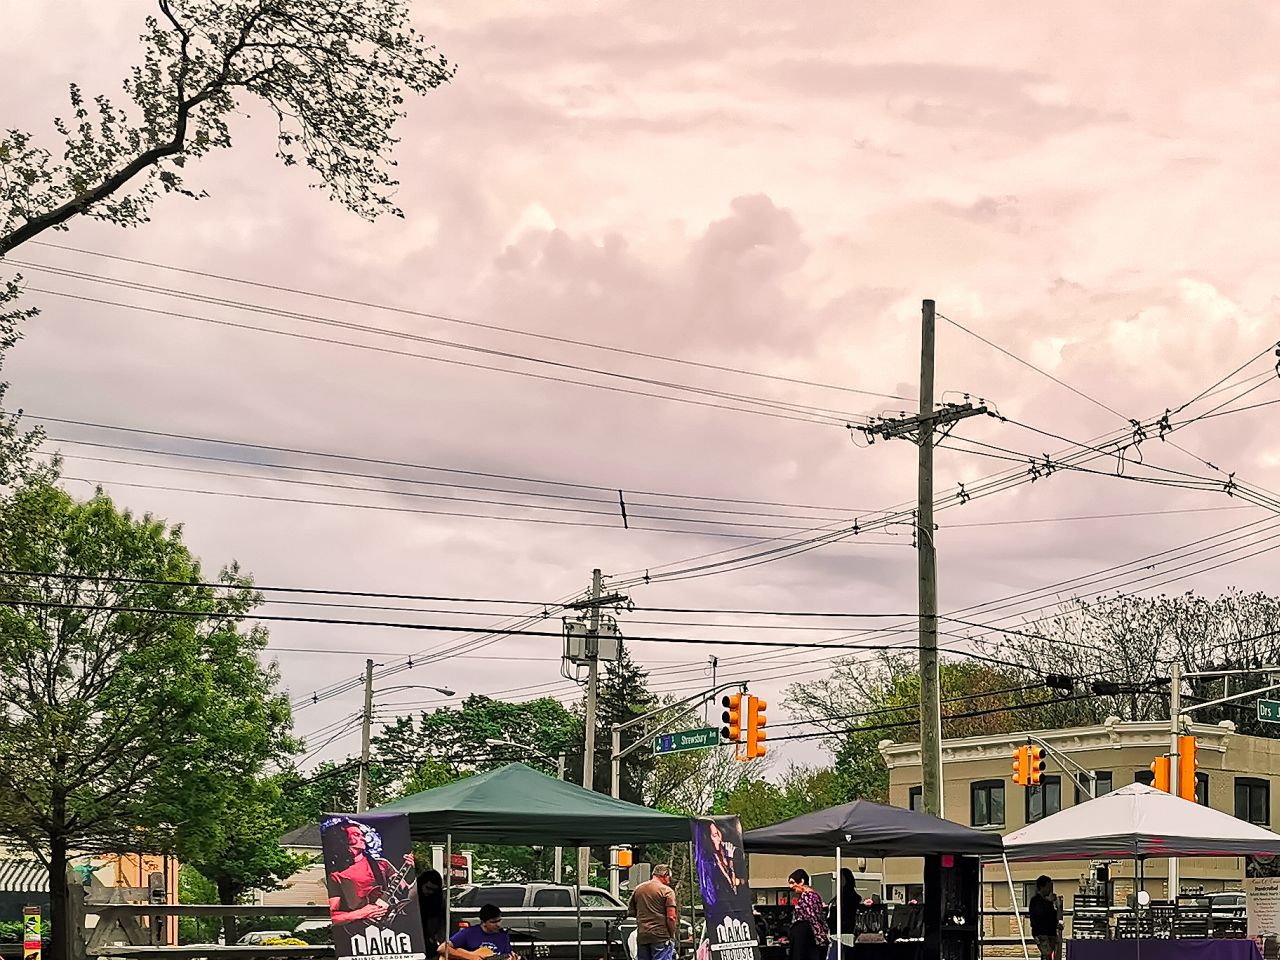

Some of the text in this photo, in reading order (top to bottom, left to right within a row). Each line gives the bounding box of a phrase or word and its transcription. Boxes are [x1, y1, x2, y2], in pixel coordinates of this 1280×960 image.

[1260, 705, 1271, 717] Drs
[681, 733, 707, 745] Shrewsbury
[354, 936, 409, 955] LAKE
